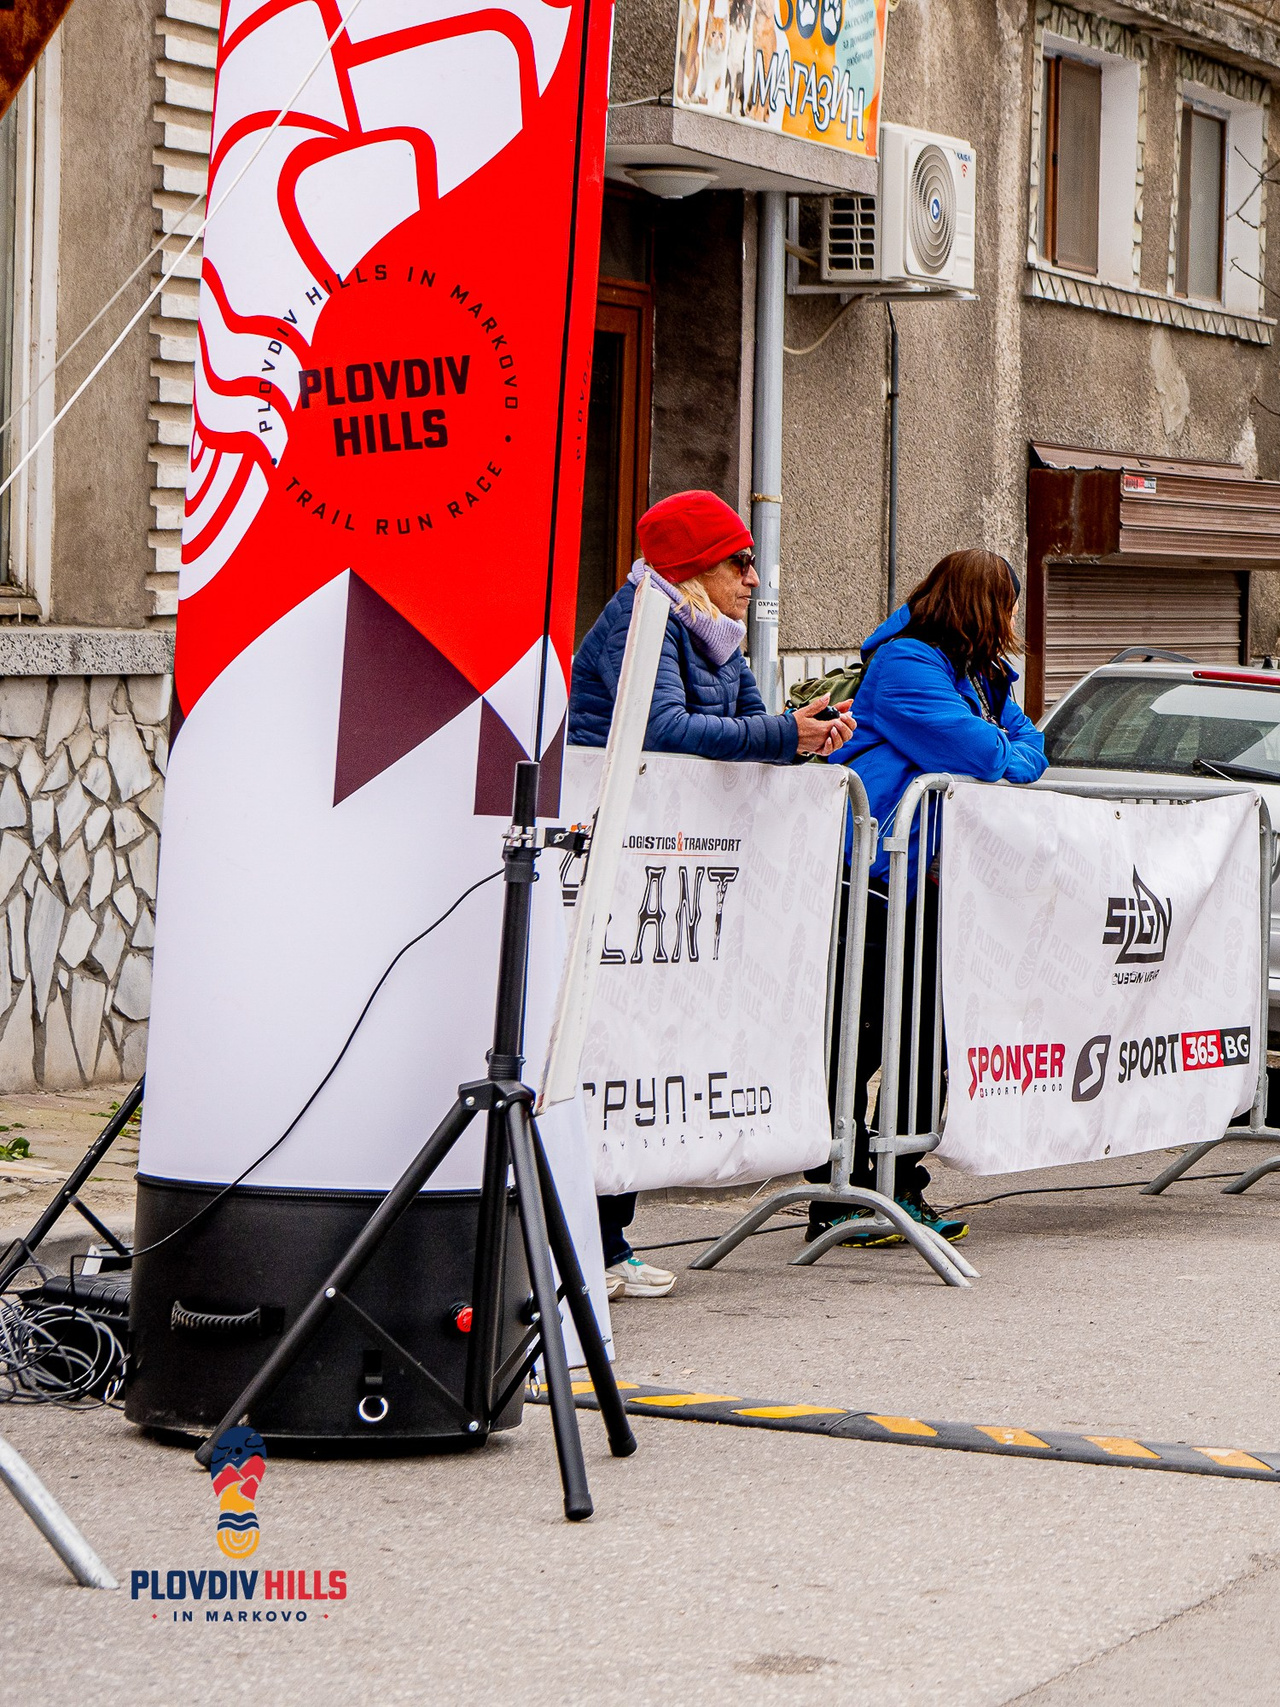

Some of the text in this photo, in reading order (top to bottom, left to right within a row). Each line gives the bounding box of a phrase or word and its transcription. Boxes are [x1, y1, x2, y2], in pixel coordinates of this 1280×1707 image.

[752, 49, 865, 140] МАГАЗИН
[258, 264, 518, 433] PLOVDIV HILLS IN MARKOVO
[298, 355, 471, 409] PLOVDIV
[333, 409, 448, 457] HILLS
[285, 461, 502, 535] TRAIL RUN RACE
[967, 1043, 1066, 1101] SPONSER
[1118, 1033, 1180, 1083] SPORT
[1033, 1083, 1063, 1093] FOOD
